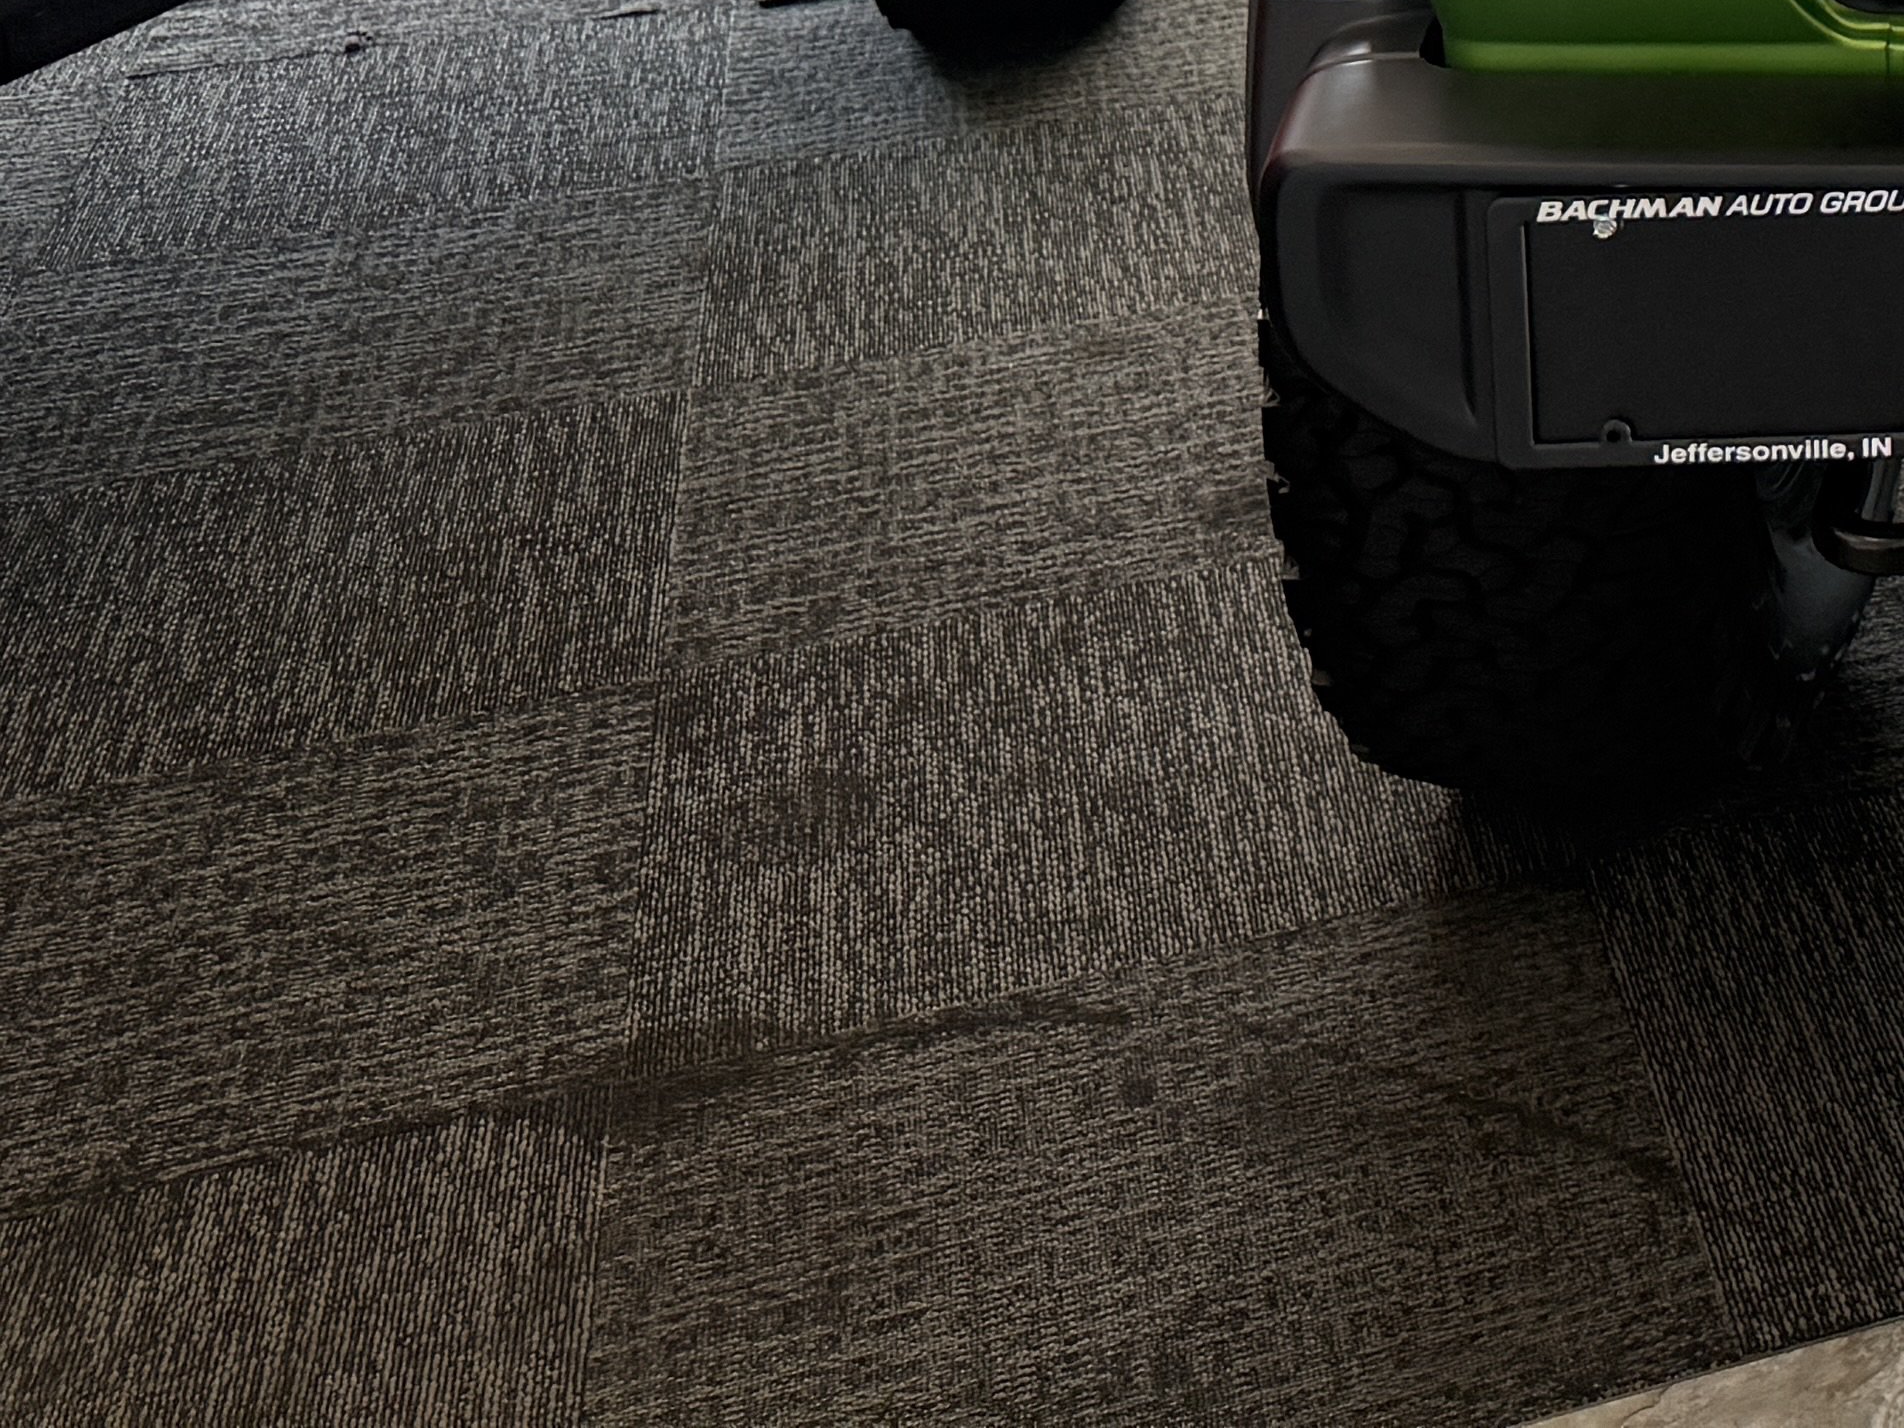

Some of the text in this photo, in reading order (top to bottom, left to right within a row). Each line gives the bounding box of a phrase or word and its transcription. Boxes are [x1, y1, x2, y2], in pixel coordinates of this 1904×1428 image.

[1536, 195, 1722, 224] BACHMAN
[1724, 192, 1814, 217] AUTO
[1653, 436, 1893, 466] Jeffersonville, IN
